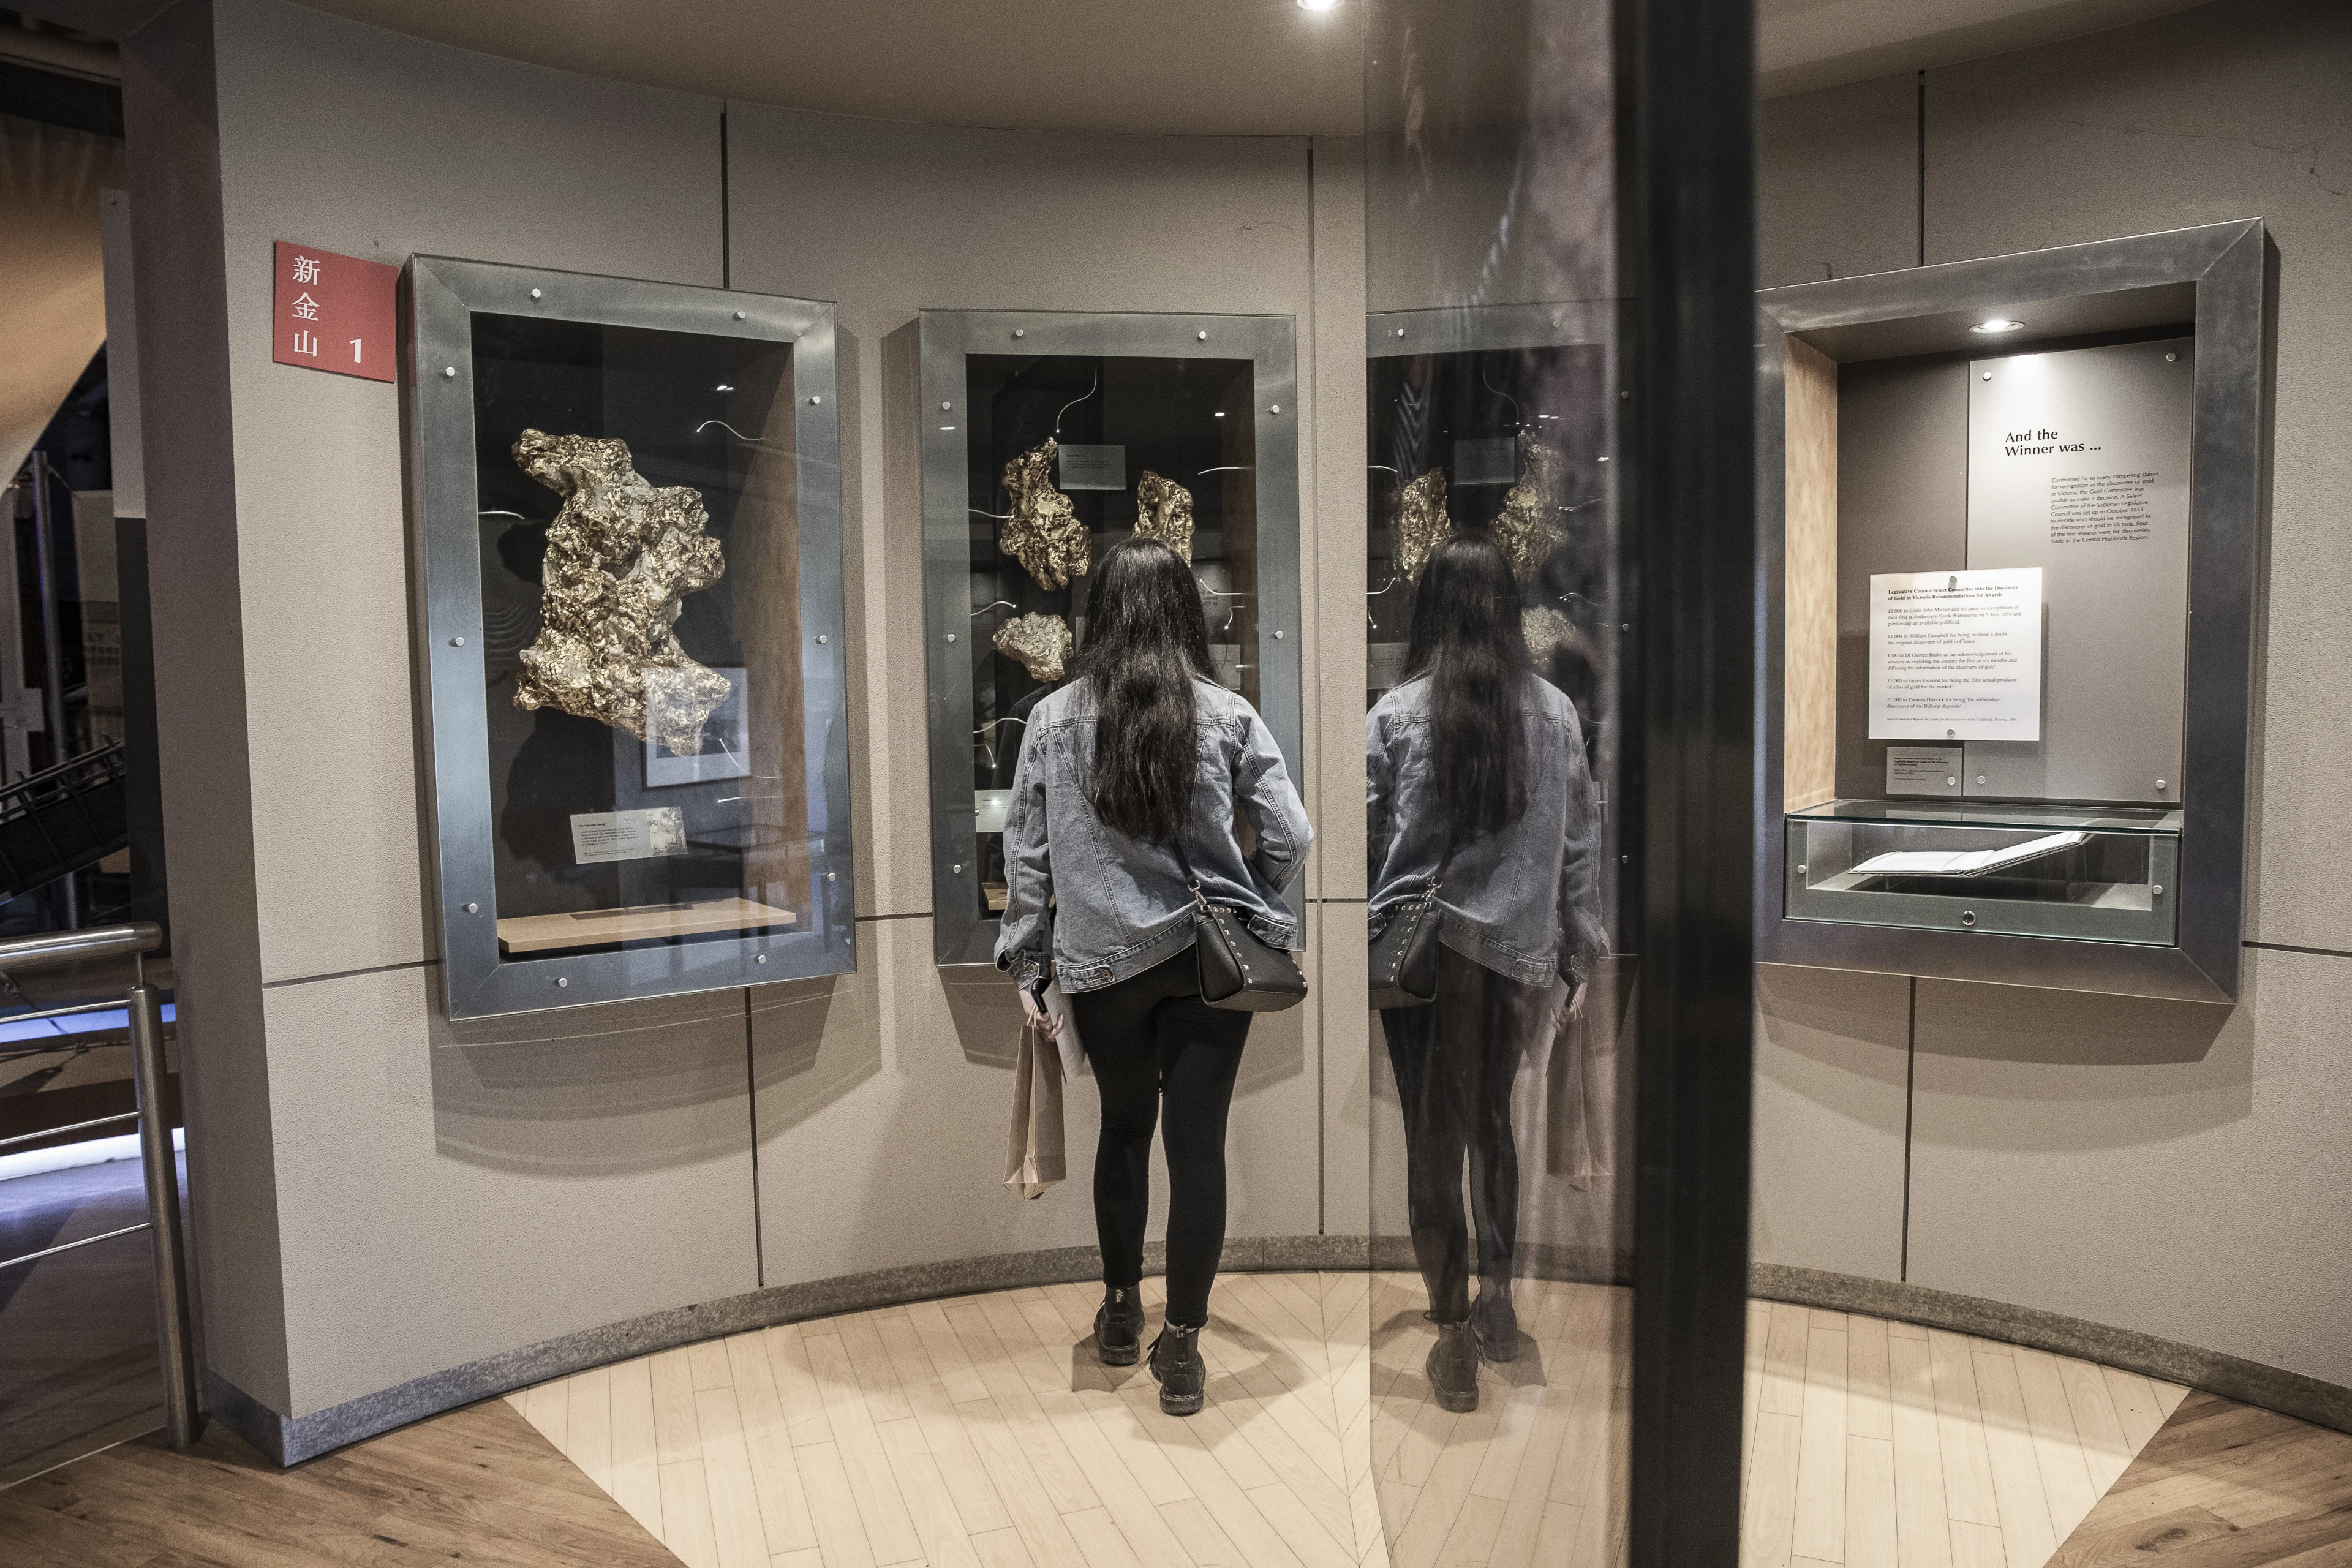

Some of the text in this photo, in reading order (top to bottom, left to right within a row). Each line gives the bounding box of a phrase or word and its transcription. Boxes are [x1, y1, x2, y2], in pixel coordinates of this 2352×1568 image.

[292, 255, 321, 357] 新金山
[350, 338, 361, 363] 1
[2005, 429, 2058, 442] And the
[2005, 443, 2054, 456] Winner
[2059, 443, 2084, 453] was
